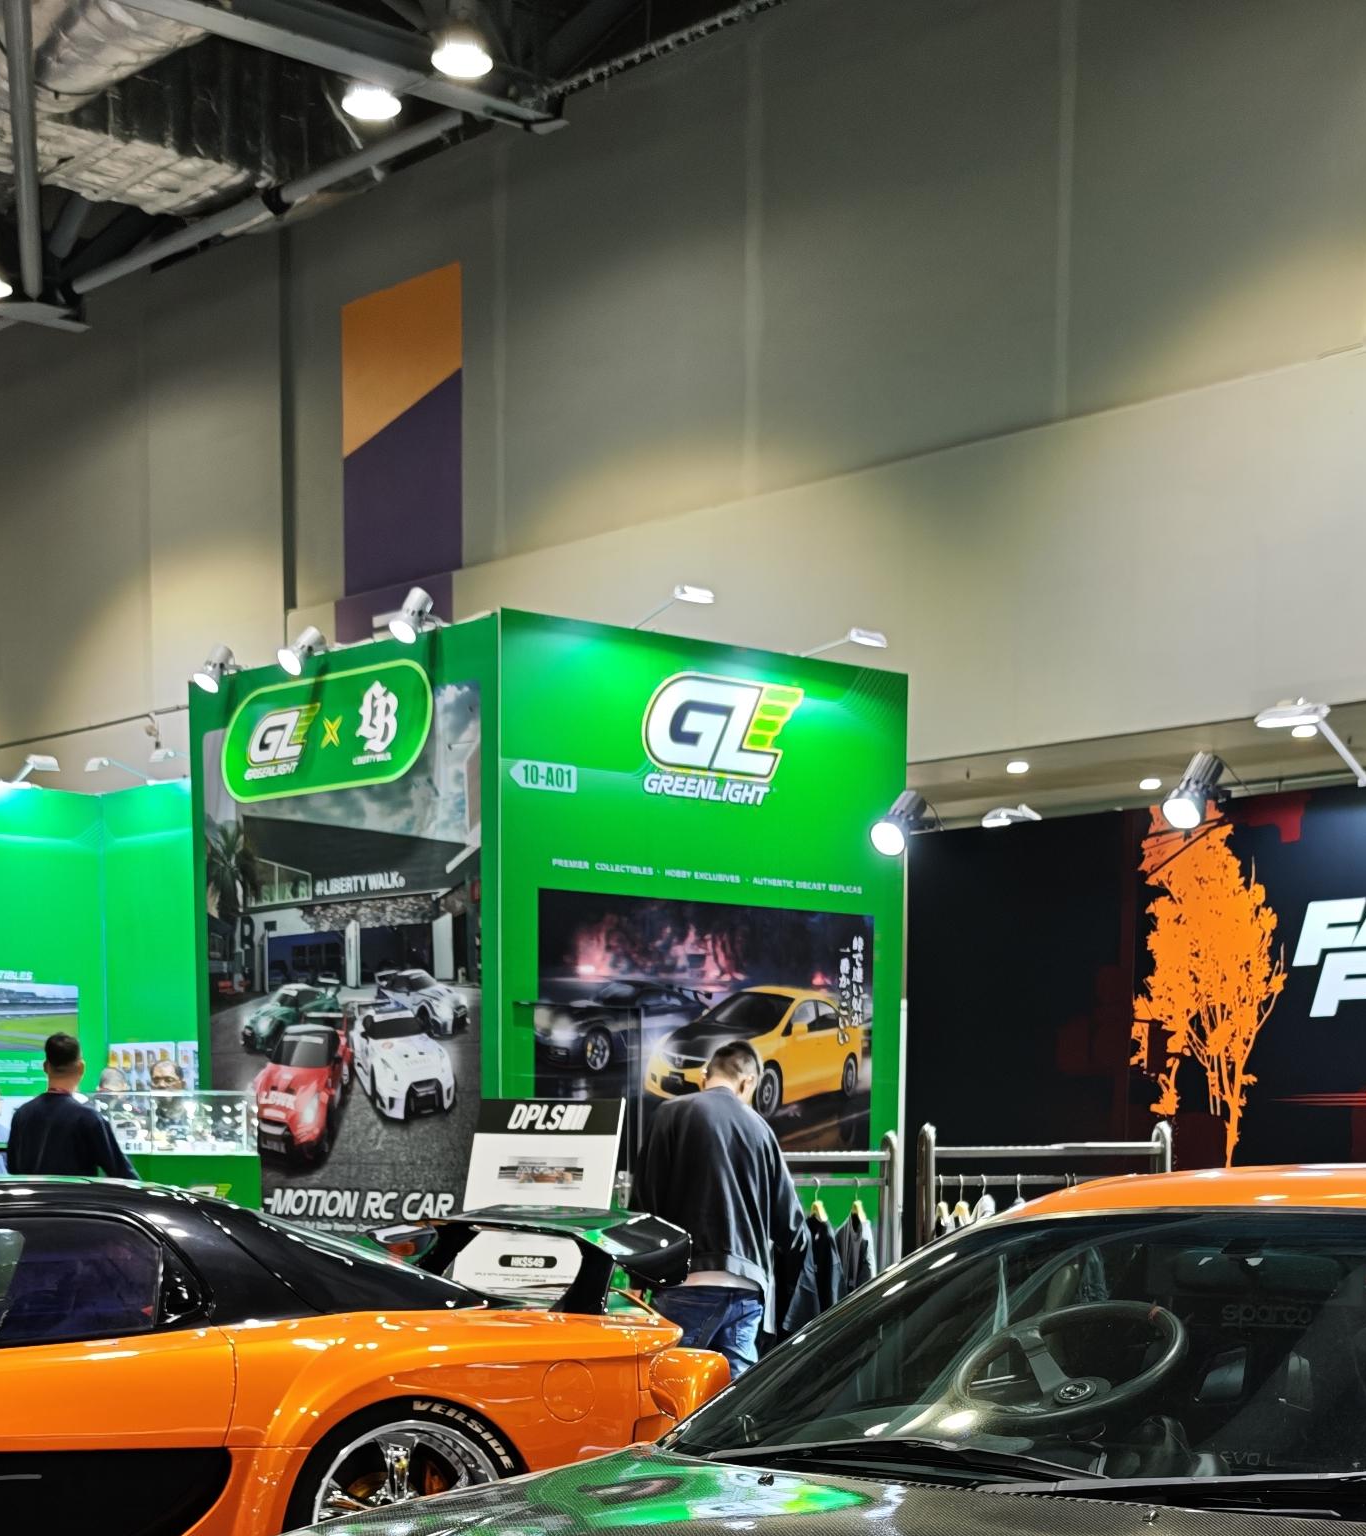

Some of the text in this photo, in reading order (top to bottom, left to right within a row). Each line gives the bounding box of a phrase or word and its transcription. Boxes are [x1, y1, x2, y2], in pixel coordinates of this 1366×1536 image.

[522, 764, 572, 788] 10-A01
[643, 772, 770, 806] GREENLIGHT
[595, 862, 653, 876] COLLECTIBLES
[507, 1104, 565, 1130] DPLS
[362, 1191, 398, 1219] RC
[402, 1193, 455, 1221] CAR
[1221, 1304, 1313, 1327] sparco
[411, 1399, 515, 1472] VEILSIDE
